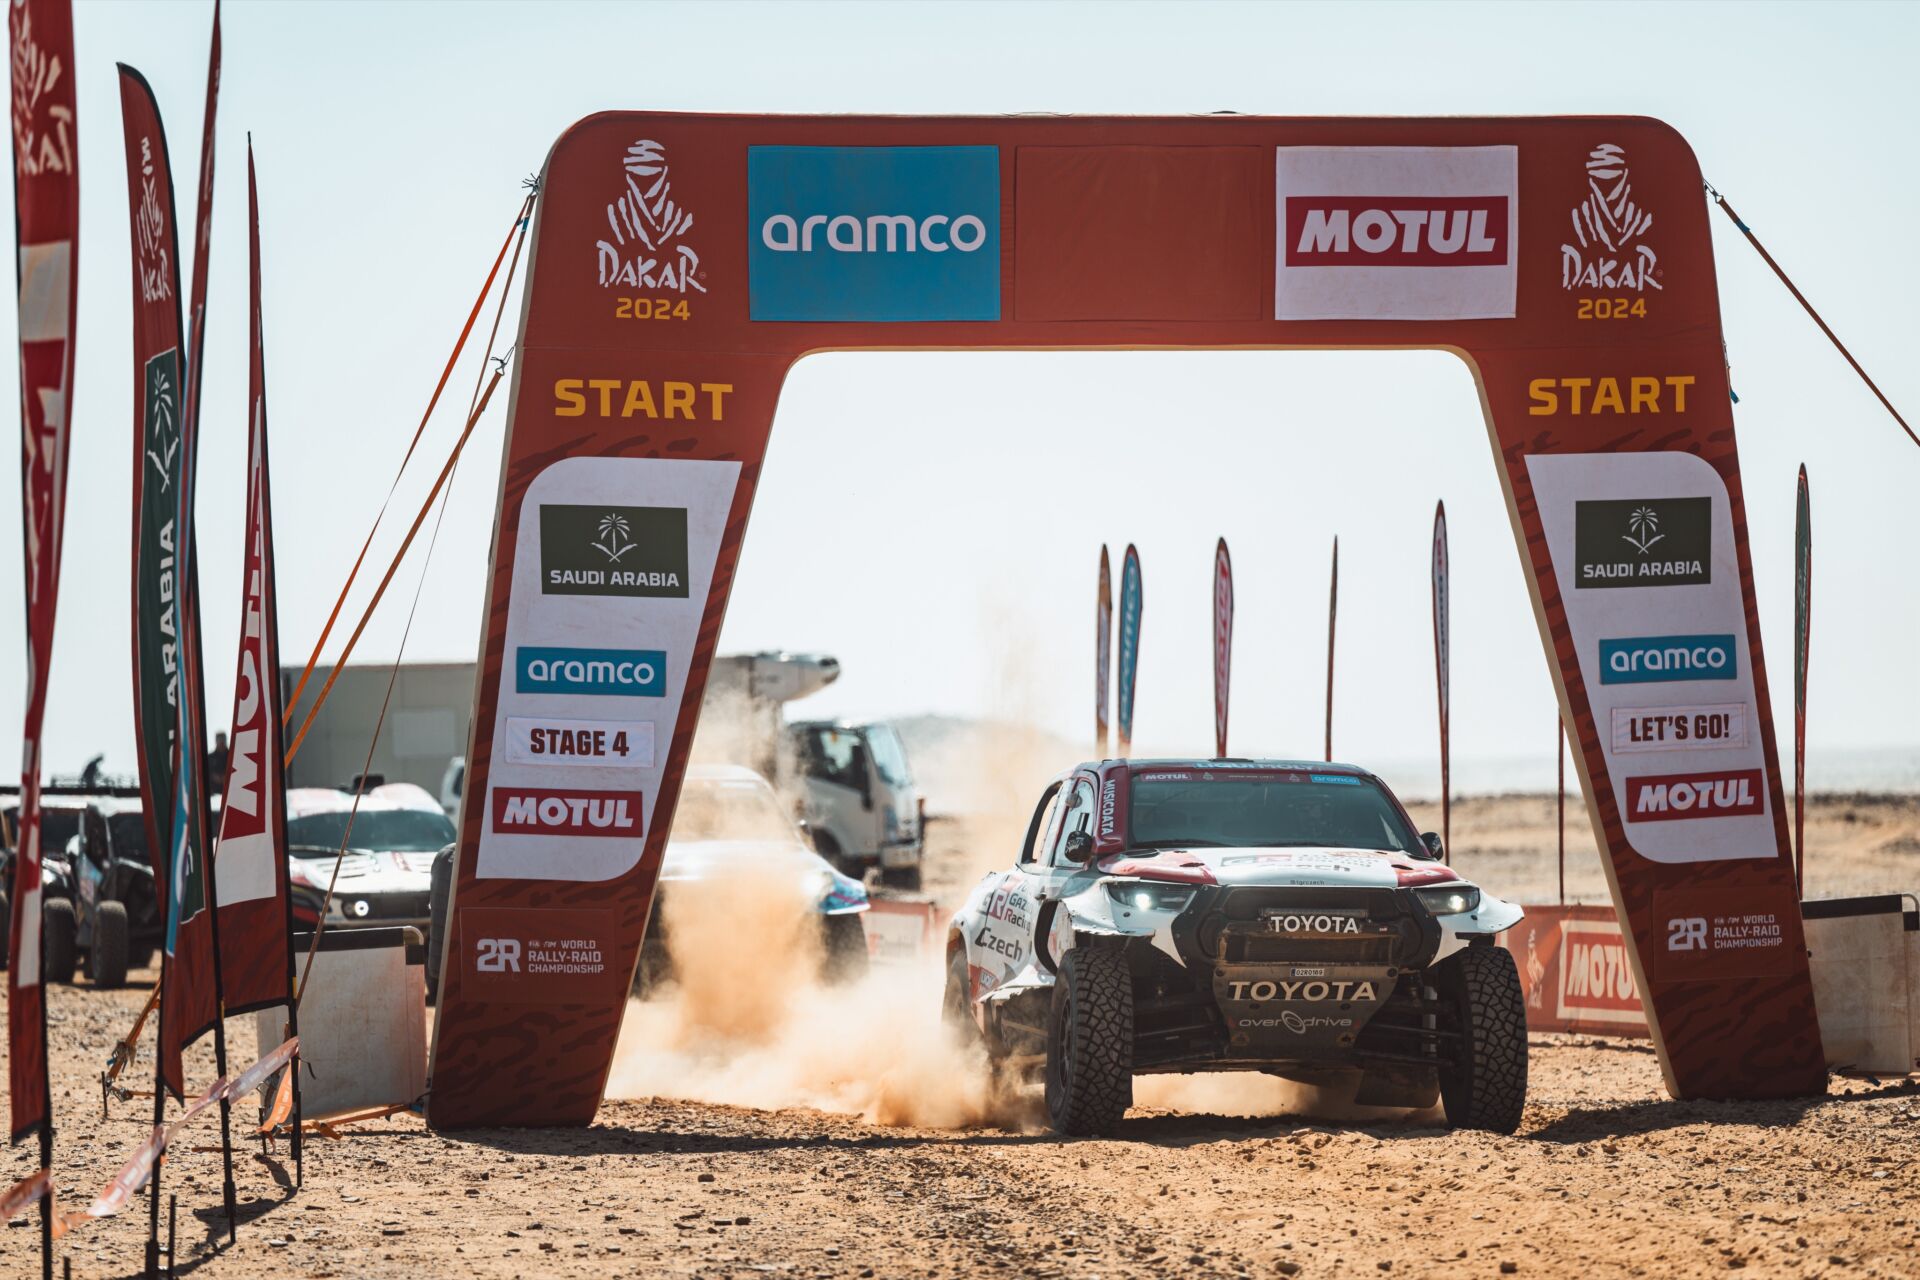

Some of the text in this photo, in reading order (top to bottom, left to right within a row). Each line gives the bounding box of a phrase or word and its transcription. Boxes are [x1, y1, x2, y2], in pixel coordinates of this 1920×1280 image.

[762, 214, 987, 252] aramco
[1297, 208, 1496, 254] MOTUL
[596, 240, 707, 293] DAKAR
[1561, 243, 1663, 292] DAKAR
[615, 297, 691, 321] 2024
[1577, 297, 1647, 320] 2024
[554, 378, 733, 421] START
[1529, 375, 1696, 416] START
[550, 569, 680, 588] SAUDI ARABIA
[1583, 560, 1702, 579] SAUDI ARABIA
[160, 518, 178, 707] ARABIA
[527, 659, 654, 685] aramco
[1610, 646, 1726, 672] aramco
[1630, 713, 1730, 743] LET'S GO!
[530, 728, 630, 757] STAGE 4
[1314, 776, 1357, 784] aramco
[1101, 779, 1116, 835] MUSICDATA
[1636, 778, 1754, 813] MOTUL
[502, 796, 633, 827] MOTUL
[1271, 915, 1359, 934] TOYOTA
[1714, 925, 1780, 938] RALLY-RAID
[1743, 914, 1775, 924] WORLD
[560, 940, 596, 949] WORLD
[974, 926, 1023, 962] Czech
[1667, 917, 1708, 950] 2R
[1714, 937, 1783, 949] CHAMPIONSHIP
[476, 938, 521, 972] 2R
[528, 950, 602, 963] RALLY-RAID
[528, 963, 605, 974] CHAMPIONSHIP
[1229, 981, 1377, 1001] TOYOTA
